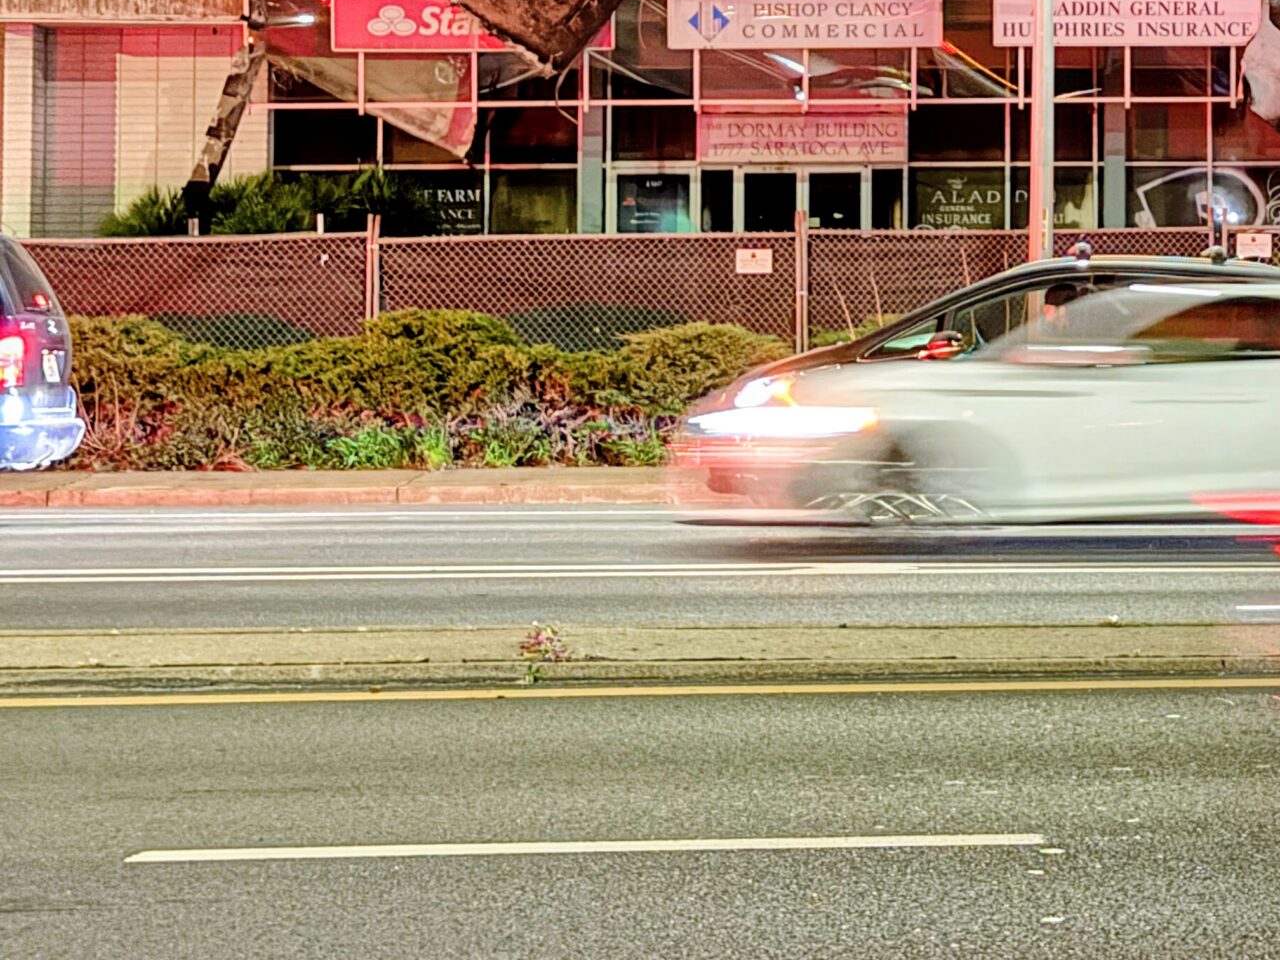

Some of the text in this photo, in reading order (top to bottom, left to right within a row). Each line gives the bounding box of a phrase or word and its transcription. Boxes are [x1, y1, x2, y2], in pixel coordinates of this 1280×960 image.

[753, 2, 913, 17] BISHOP CLANCY
[1031, 1, 1225, 16] ADDIN GENERAL
[742, 23, 924, 39] COMMERCIAL
[1002, 21, 1253, 37] HUPHRIES INSURANCE
[728, 123, 807, 138] DORMAY
[815, 123, 898, 138] BUILDING
[713, 142, 744, 156] 1777
[751, 141, 849, 156] SARATOGA
[437, 189, 481, 203] FARM
[922, 213, 992, 225] INSURANCE
